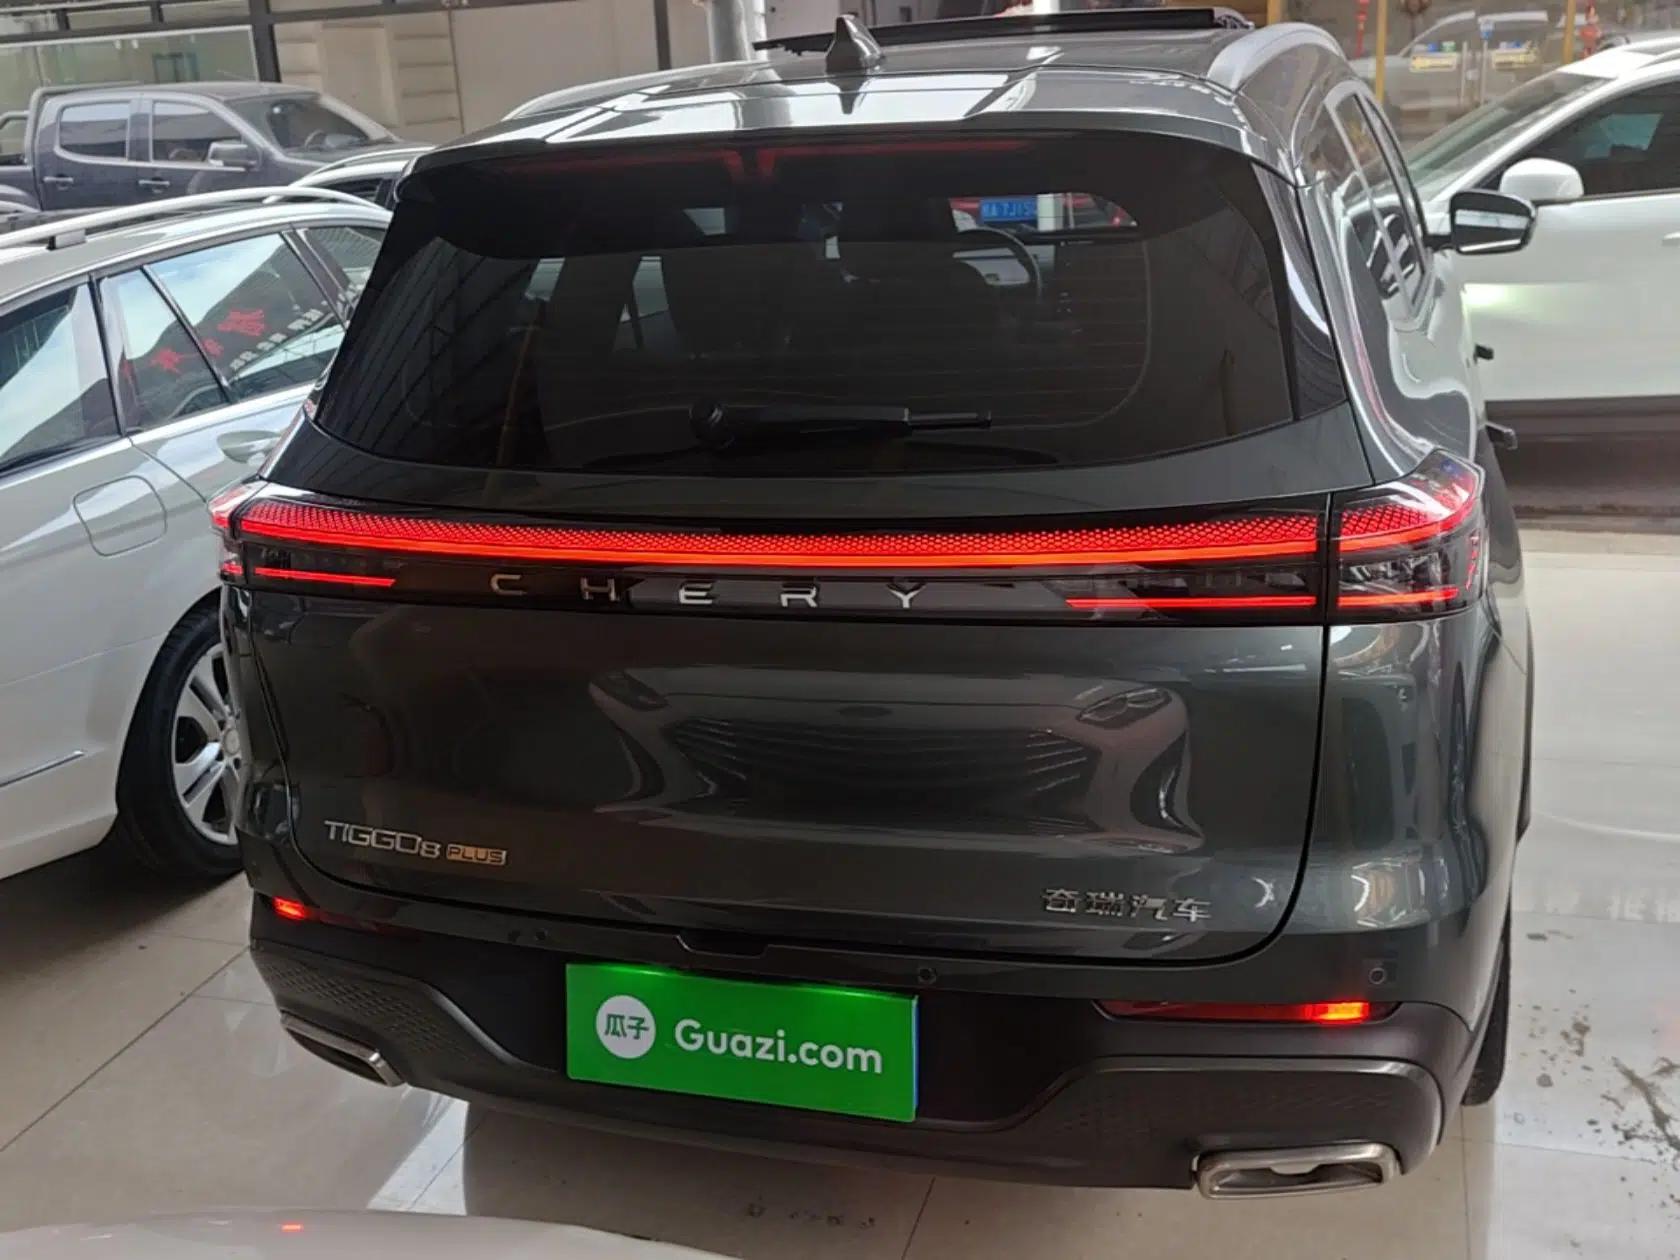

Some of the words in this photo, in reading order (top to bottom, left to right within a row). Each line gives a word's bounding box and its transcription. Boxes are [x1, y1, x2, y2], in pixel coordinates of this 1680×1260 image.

[490, 573, 926, 609] CHERY
[448, 845, 506, 865] PLUS
[1043, 888, 1212, 922] 奇瑞汽车
[604, 1013, 649, 1040] 瓜子
[675, 1018, 883, 1074] Guazi.com
